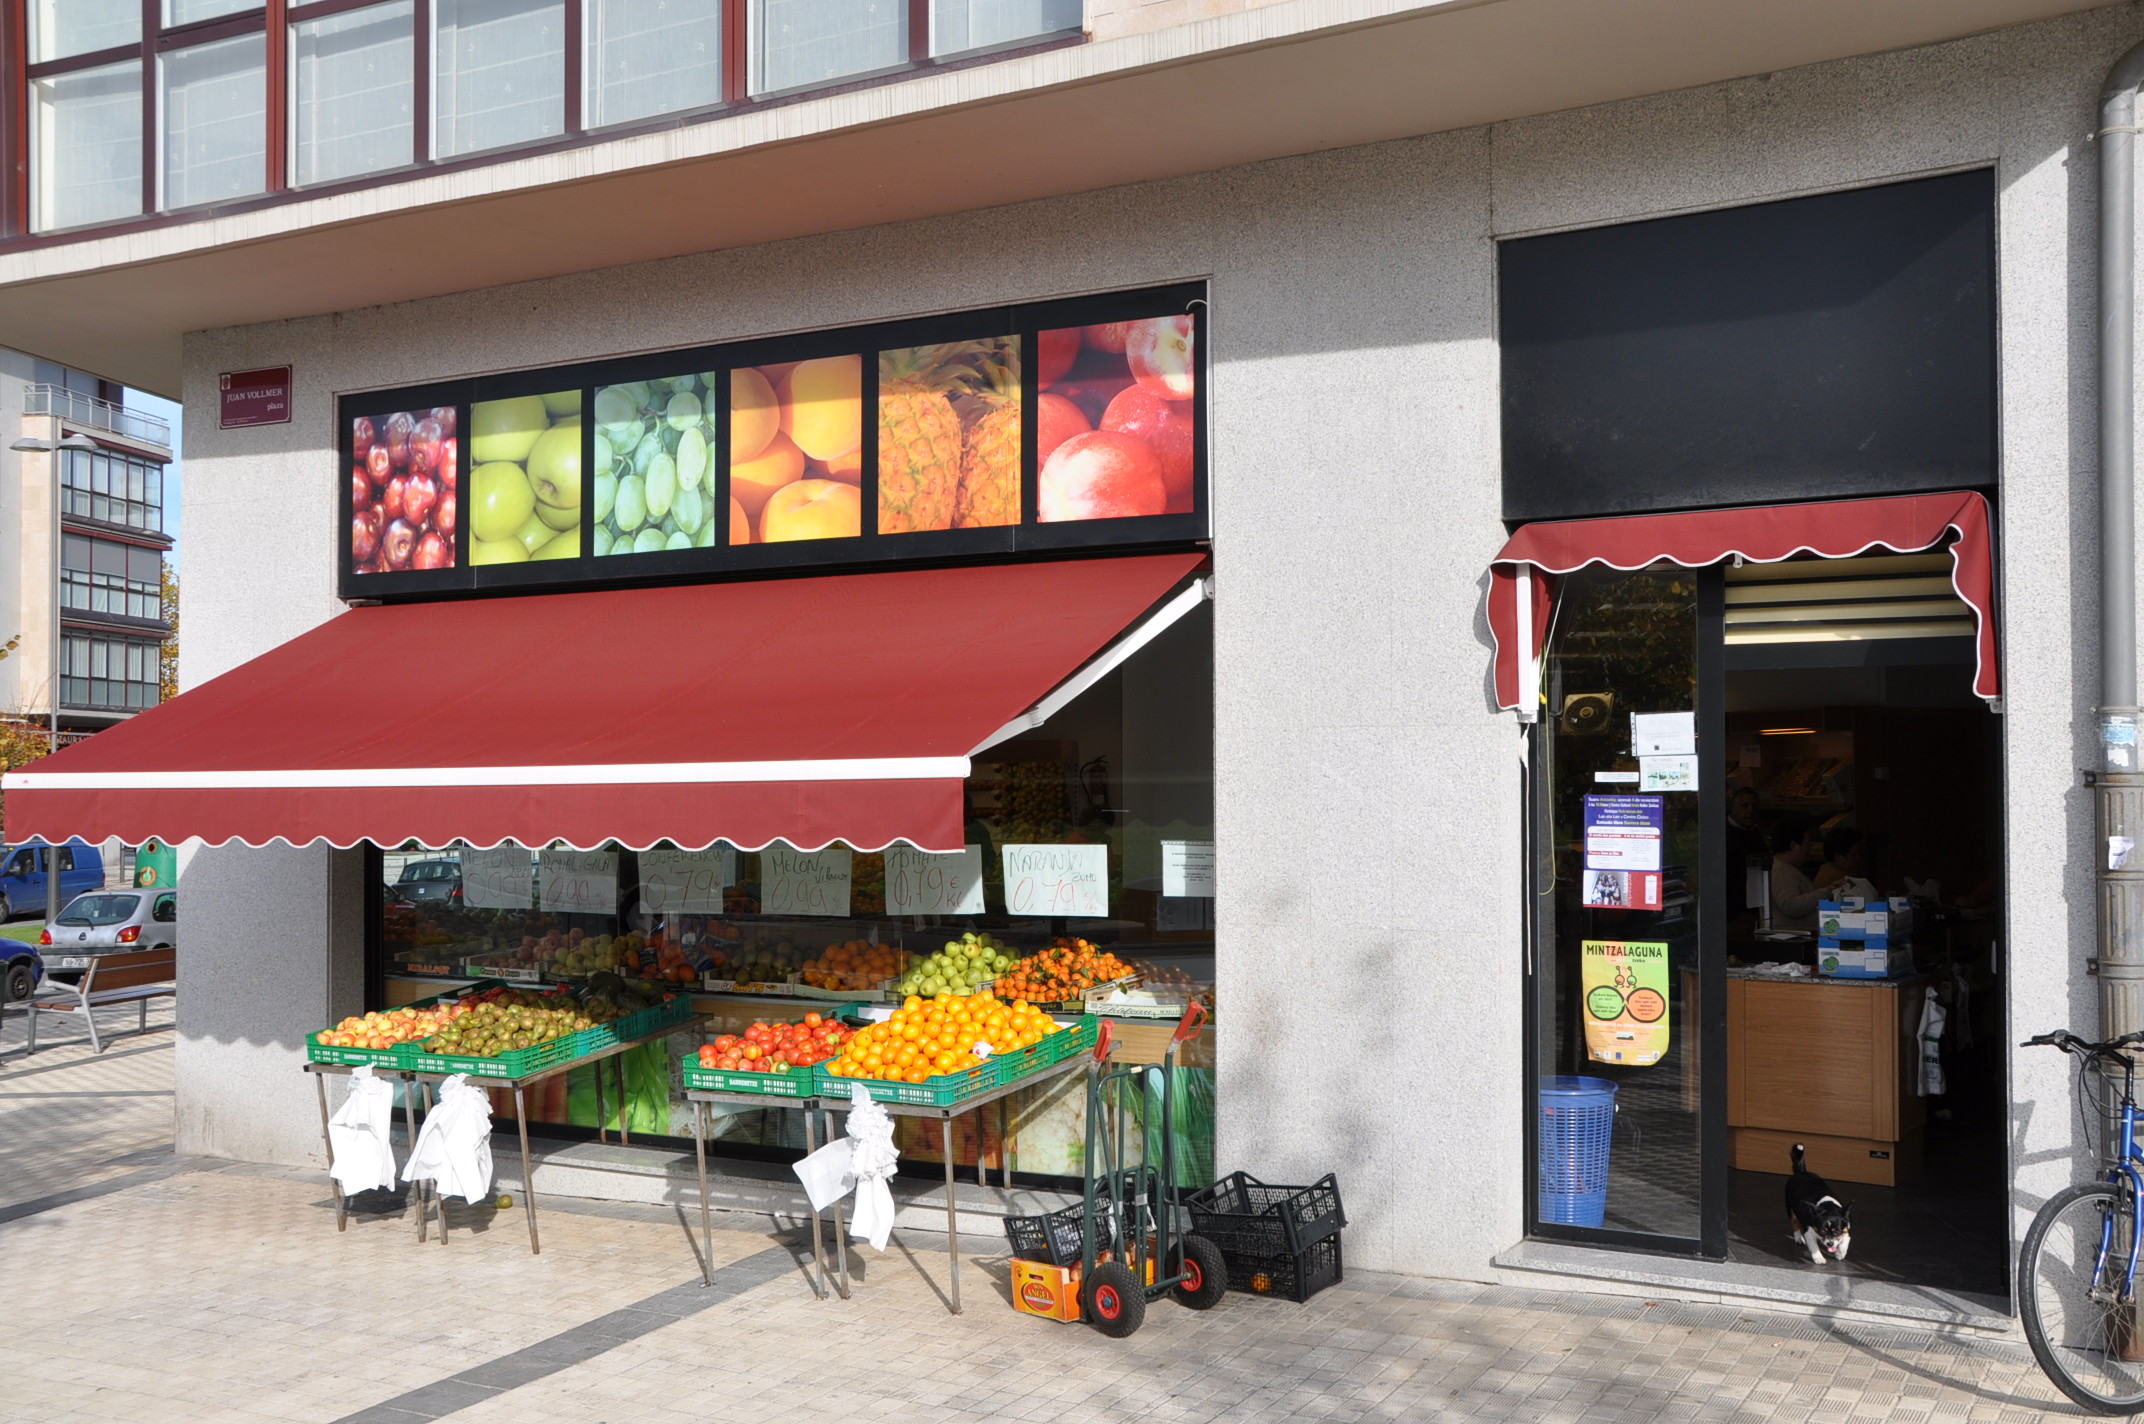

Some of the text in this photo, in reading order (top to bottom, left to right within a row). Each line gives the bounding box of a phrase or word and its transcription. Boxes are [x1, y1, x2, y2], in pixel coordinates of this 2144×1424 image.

[227, 388, 283, 403] JUAN VOLLMER
[267, 402, 284, 412] plaza
[771, 851, 823, 875] MELON
[1009, 847, 1083, 878] NARANJA
[893, 865, 944, 910] 0,79
[1013, 876, 1076, 912] 0,79
[1586, 945, 1662, 957] MINTZALAGUNA
[729, 1078, 758, 1087] BARRENETXE
[869, 1087, 894, 1096] RRENETXE
[1027, 1289, 1051, 1300] ANGEL
